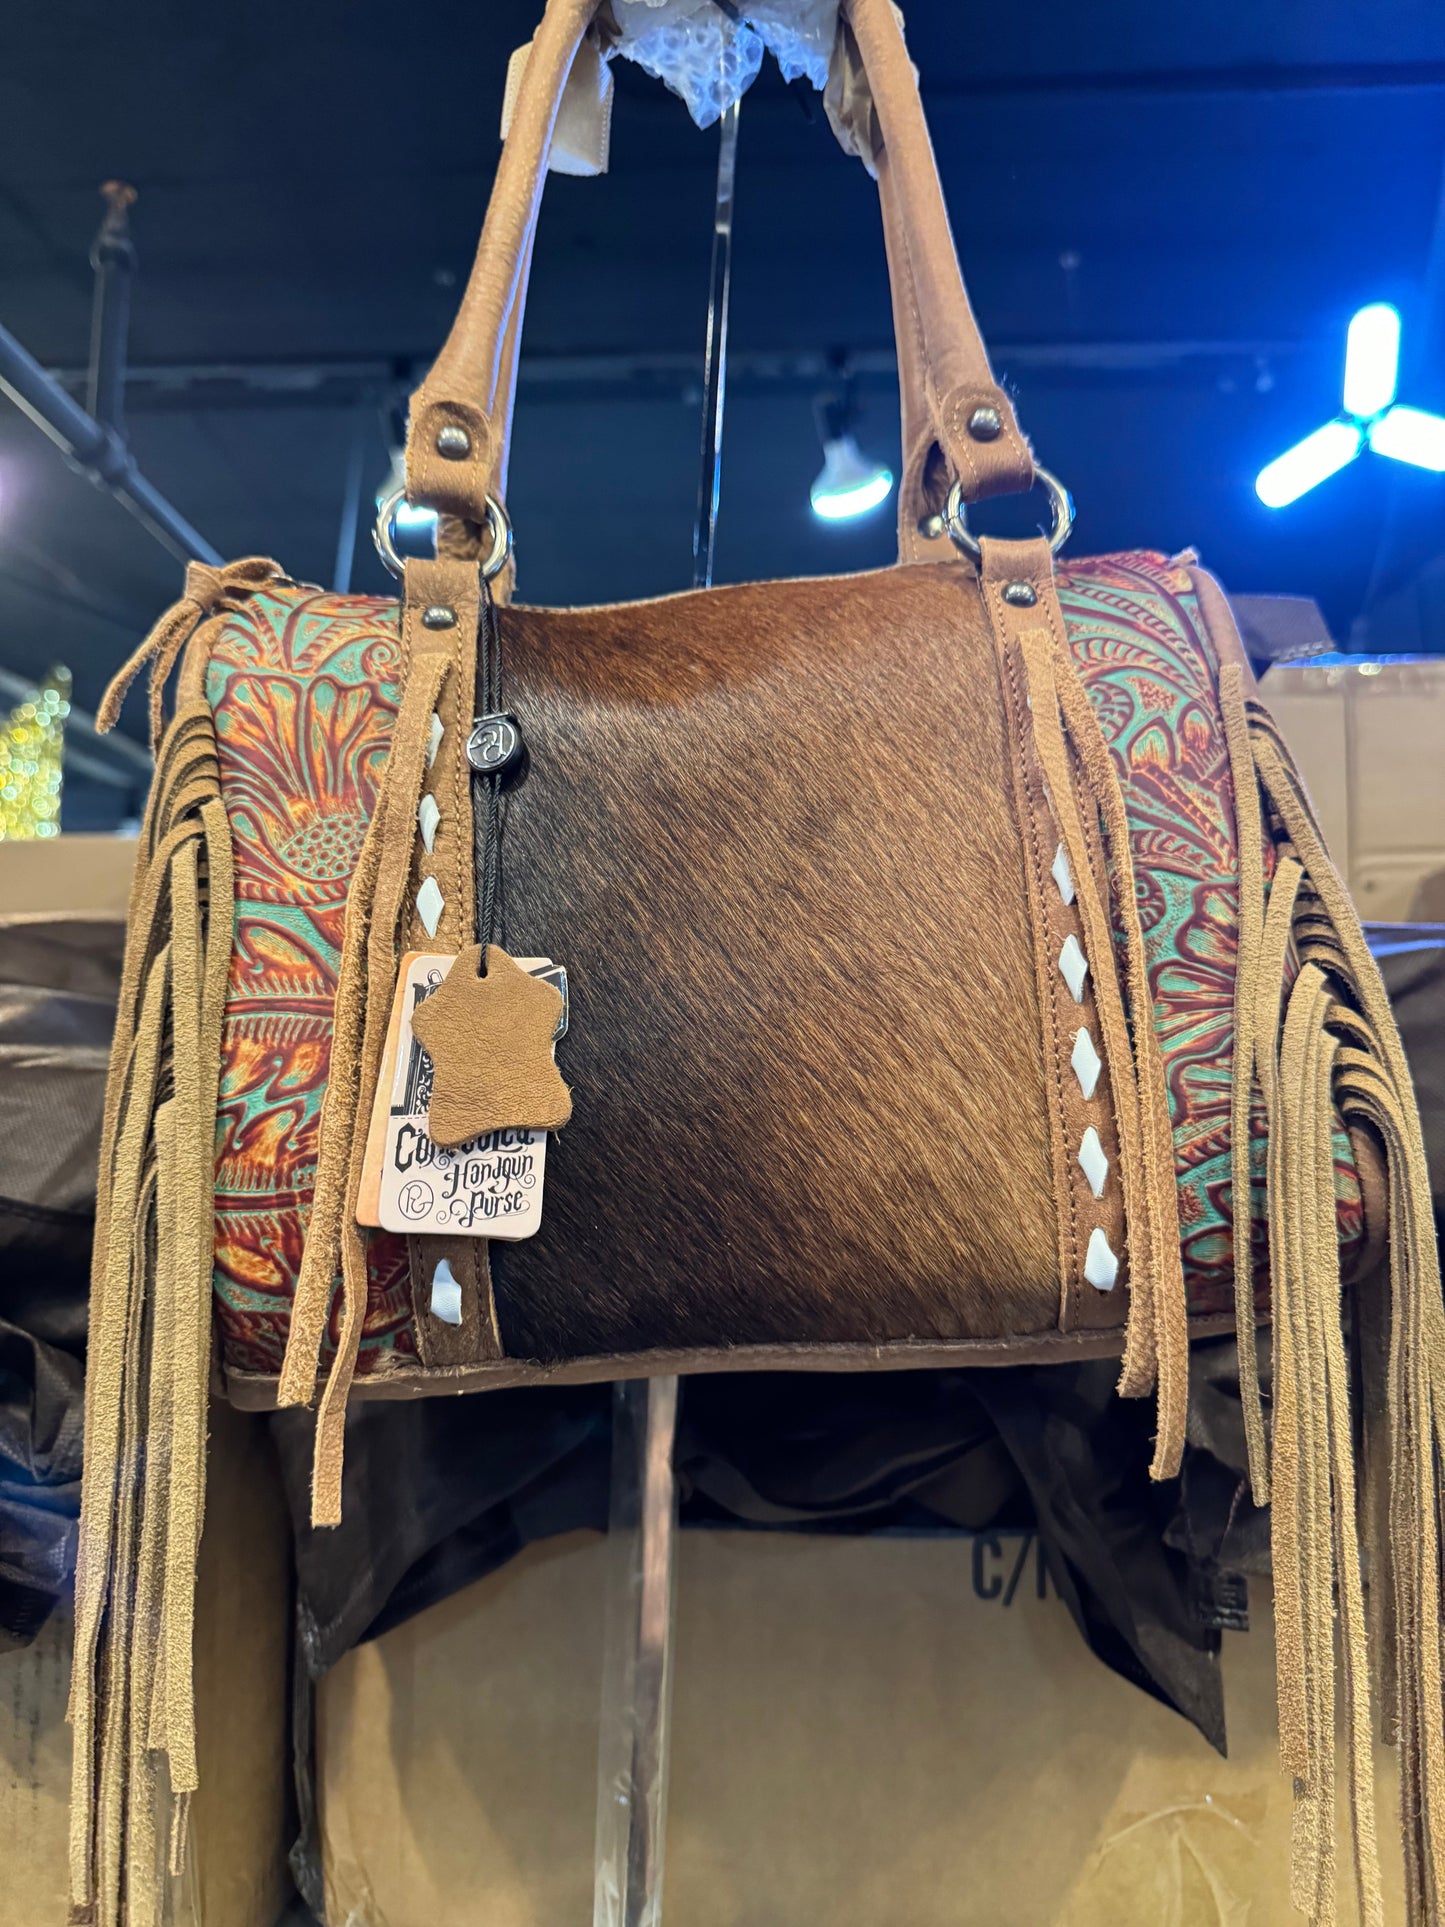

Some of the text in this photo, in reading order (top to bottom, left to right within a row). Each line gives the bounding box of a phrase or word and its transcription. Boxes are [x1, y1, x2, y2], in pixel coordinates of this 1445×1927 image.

[394, 1121, 535, 1173] Coaled
[442, 1154, 536, 1198] Handgun
[447, 1188, 530, 1228] Purse
